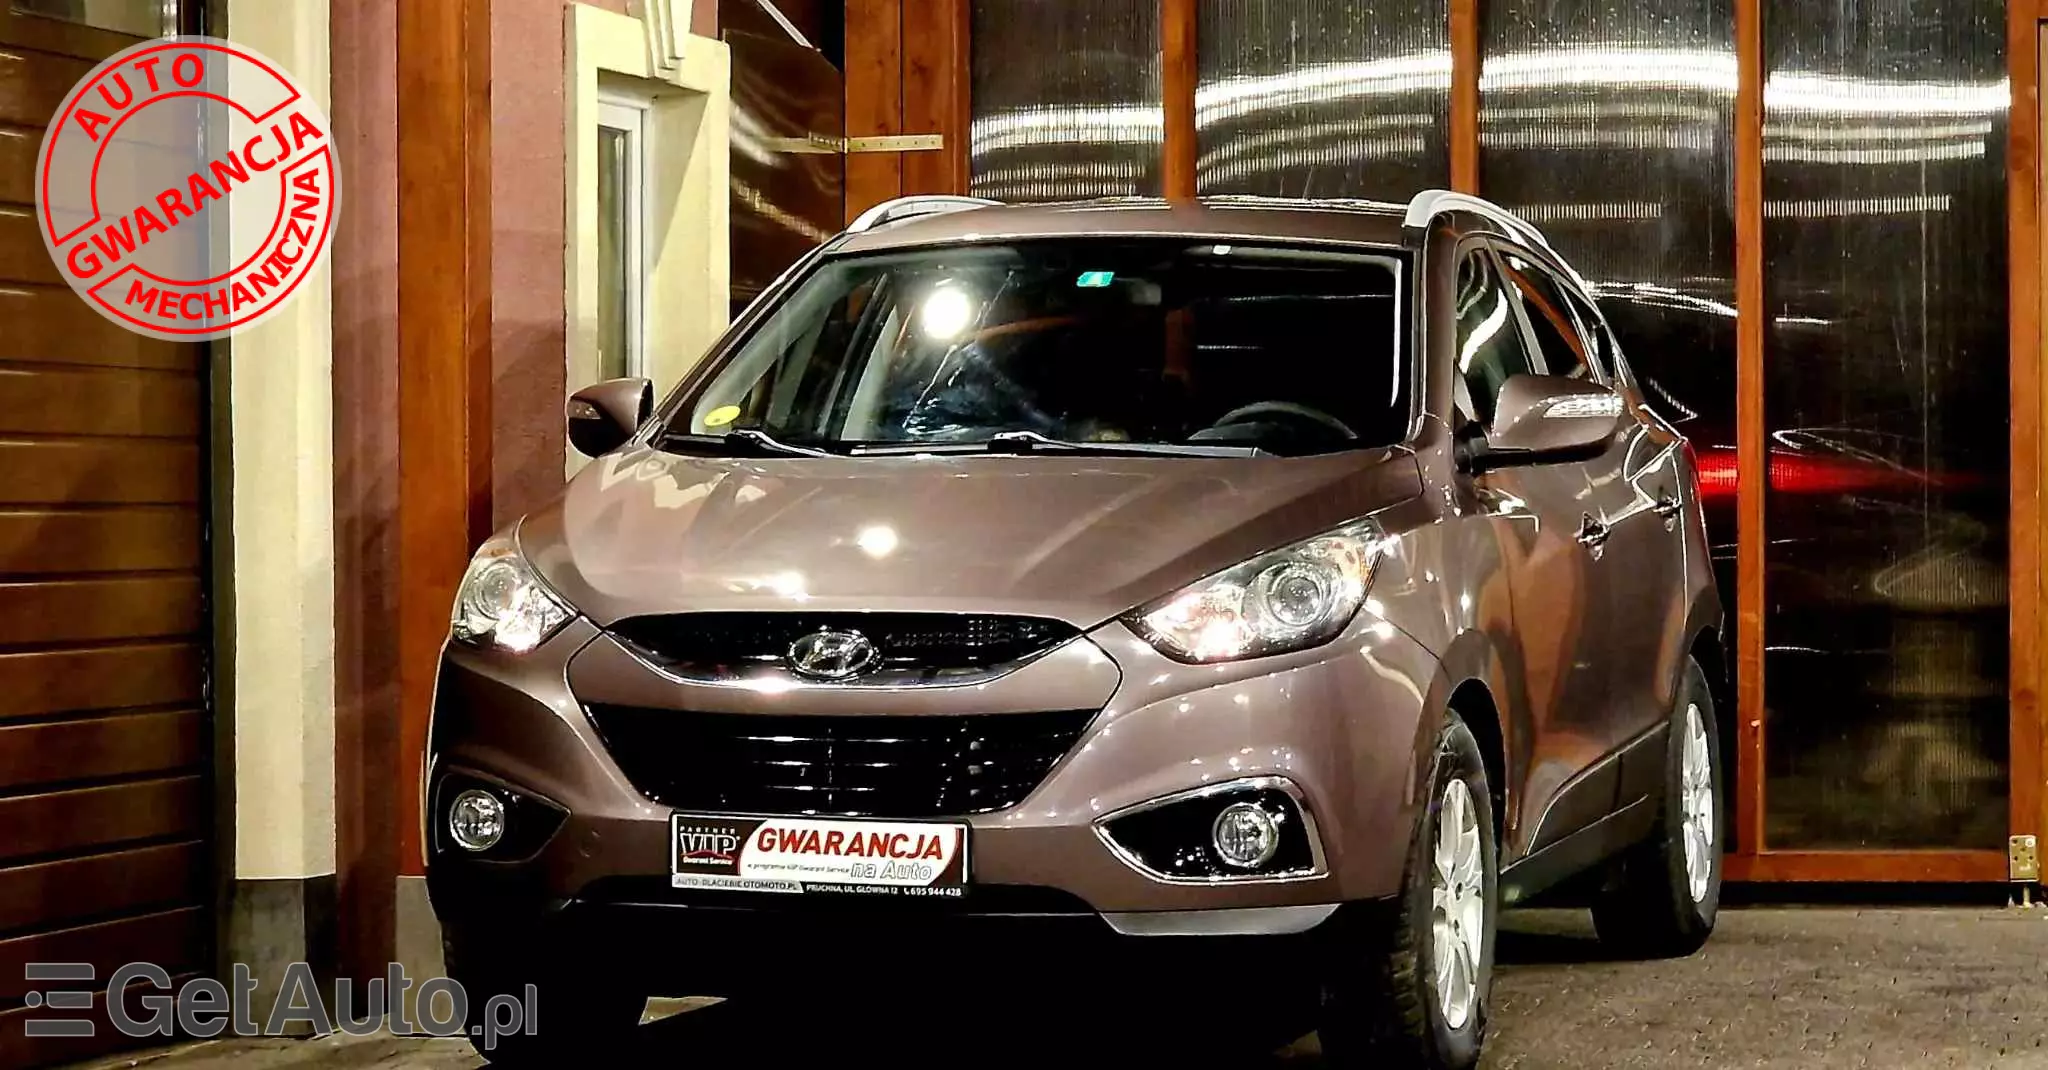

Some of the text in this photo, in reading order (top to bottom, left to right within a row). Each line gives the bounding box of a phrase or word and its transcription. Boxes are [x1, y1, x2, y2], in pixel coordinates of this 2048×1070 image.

[680, 826, 735, 834] PARTNER
[680, 833, 737, 855] VIP
[756, 827, 943, 860] GWARANCJA
[851, 860, 932, 880] na Auto
[911, 887, 927, 896] 695
[945, 888, 962, 897] 428
